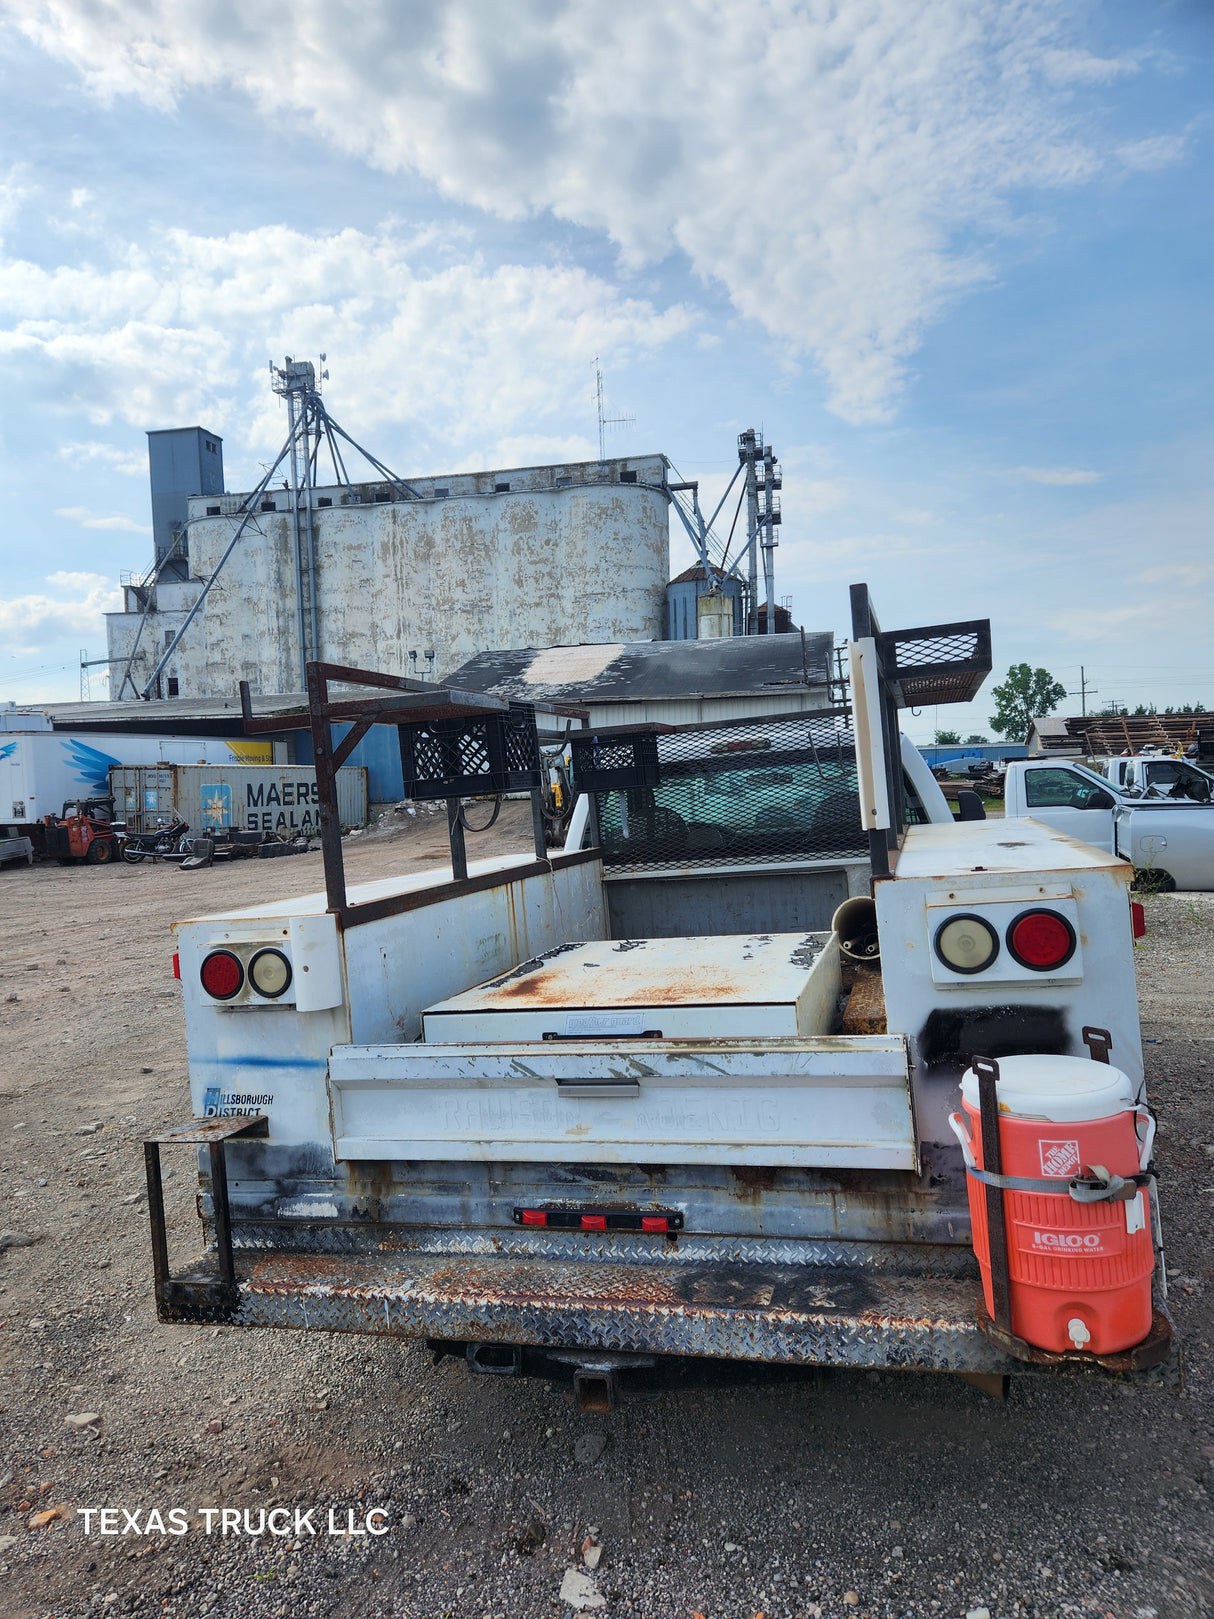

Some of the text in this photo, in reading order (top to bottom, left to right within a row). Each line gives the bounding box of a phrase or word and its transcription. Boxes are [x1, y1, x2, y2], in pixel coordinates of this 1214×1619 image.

[247, 783, 319, 807] MAERS
[247, 809, 321, 831] SEALA
[206, 1090, 273, 1105] HILLSBOROUGH
[205, 1105, 261, 1118] DISTRICT
[1043, 1141, 1078, 1175] HOME
[1034, 1232, 1100, 1248] IGLOO
